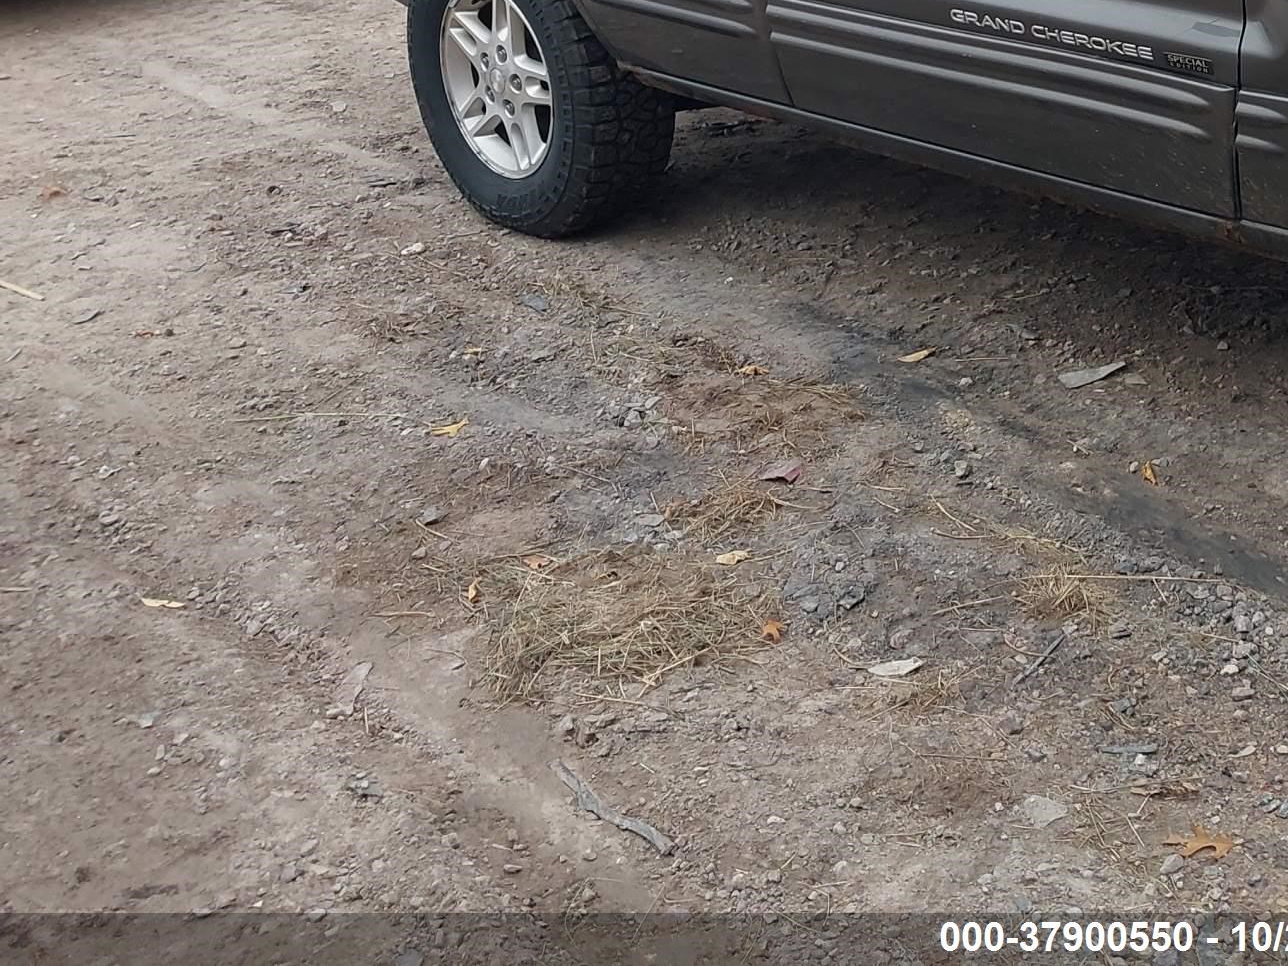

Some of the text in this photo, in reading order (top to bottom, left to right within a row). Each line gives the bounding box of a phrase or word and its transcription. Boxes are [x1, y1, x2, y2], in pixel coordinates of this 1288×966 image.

[950, 8, 1154, 61] GRAND CHEROKEE
[1167, 53, 1208, 68] SPECIAL
